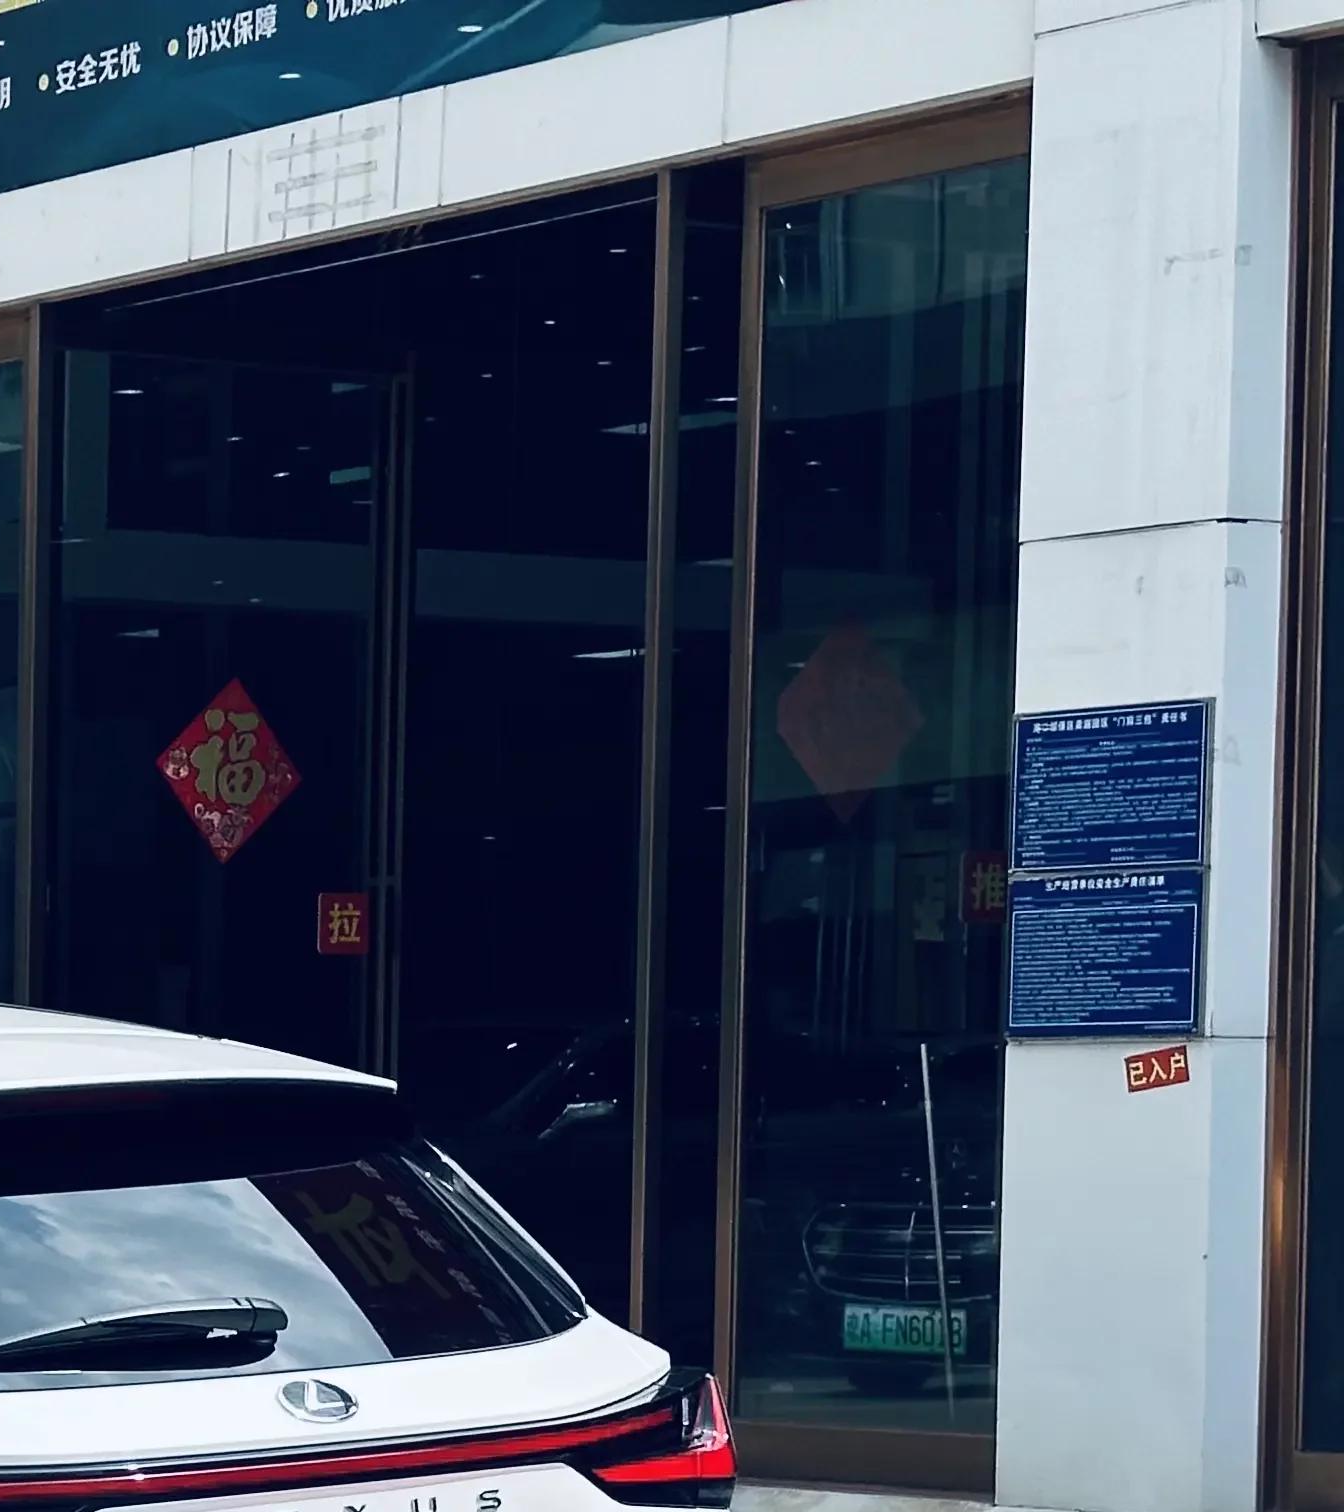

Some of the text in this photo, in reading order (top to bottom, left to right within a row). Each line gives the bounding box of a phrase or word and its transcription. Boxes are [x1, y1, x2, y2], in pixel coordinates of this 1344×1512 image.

[55, 41, 141, 94] 安全无忧
[186, 3, 278, 59] 协议保障
[190, 708, 266, 806] 福
[328, 902, 361, 945] 拉
[1128, 1053, 1186, 1088] 已入户
